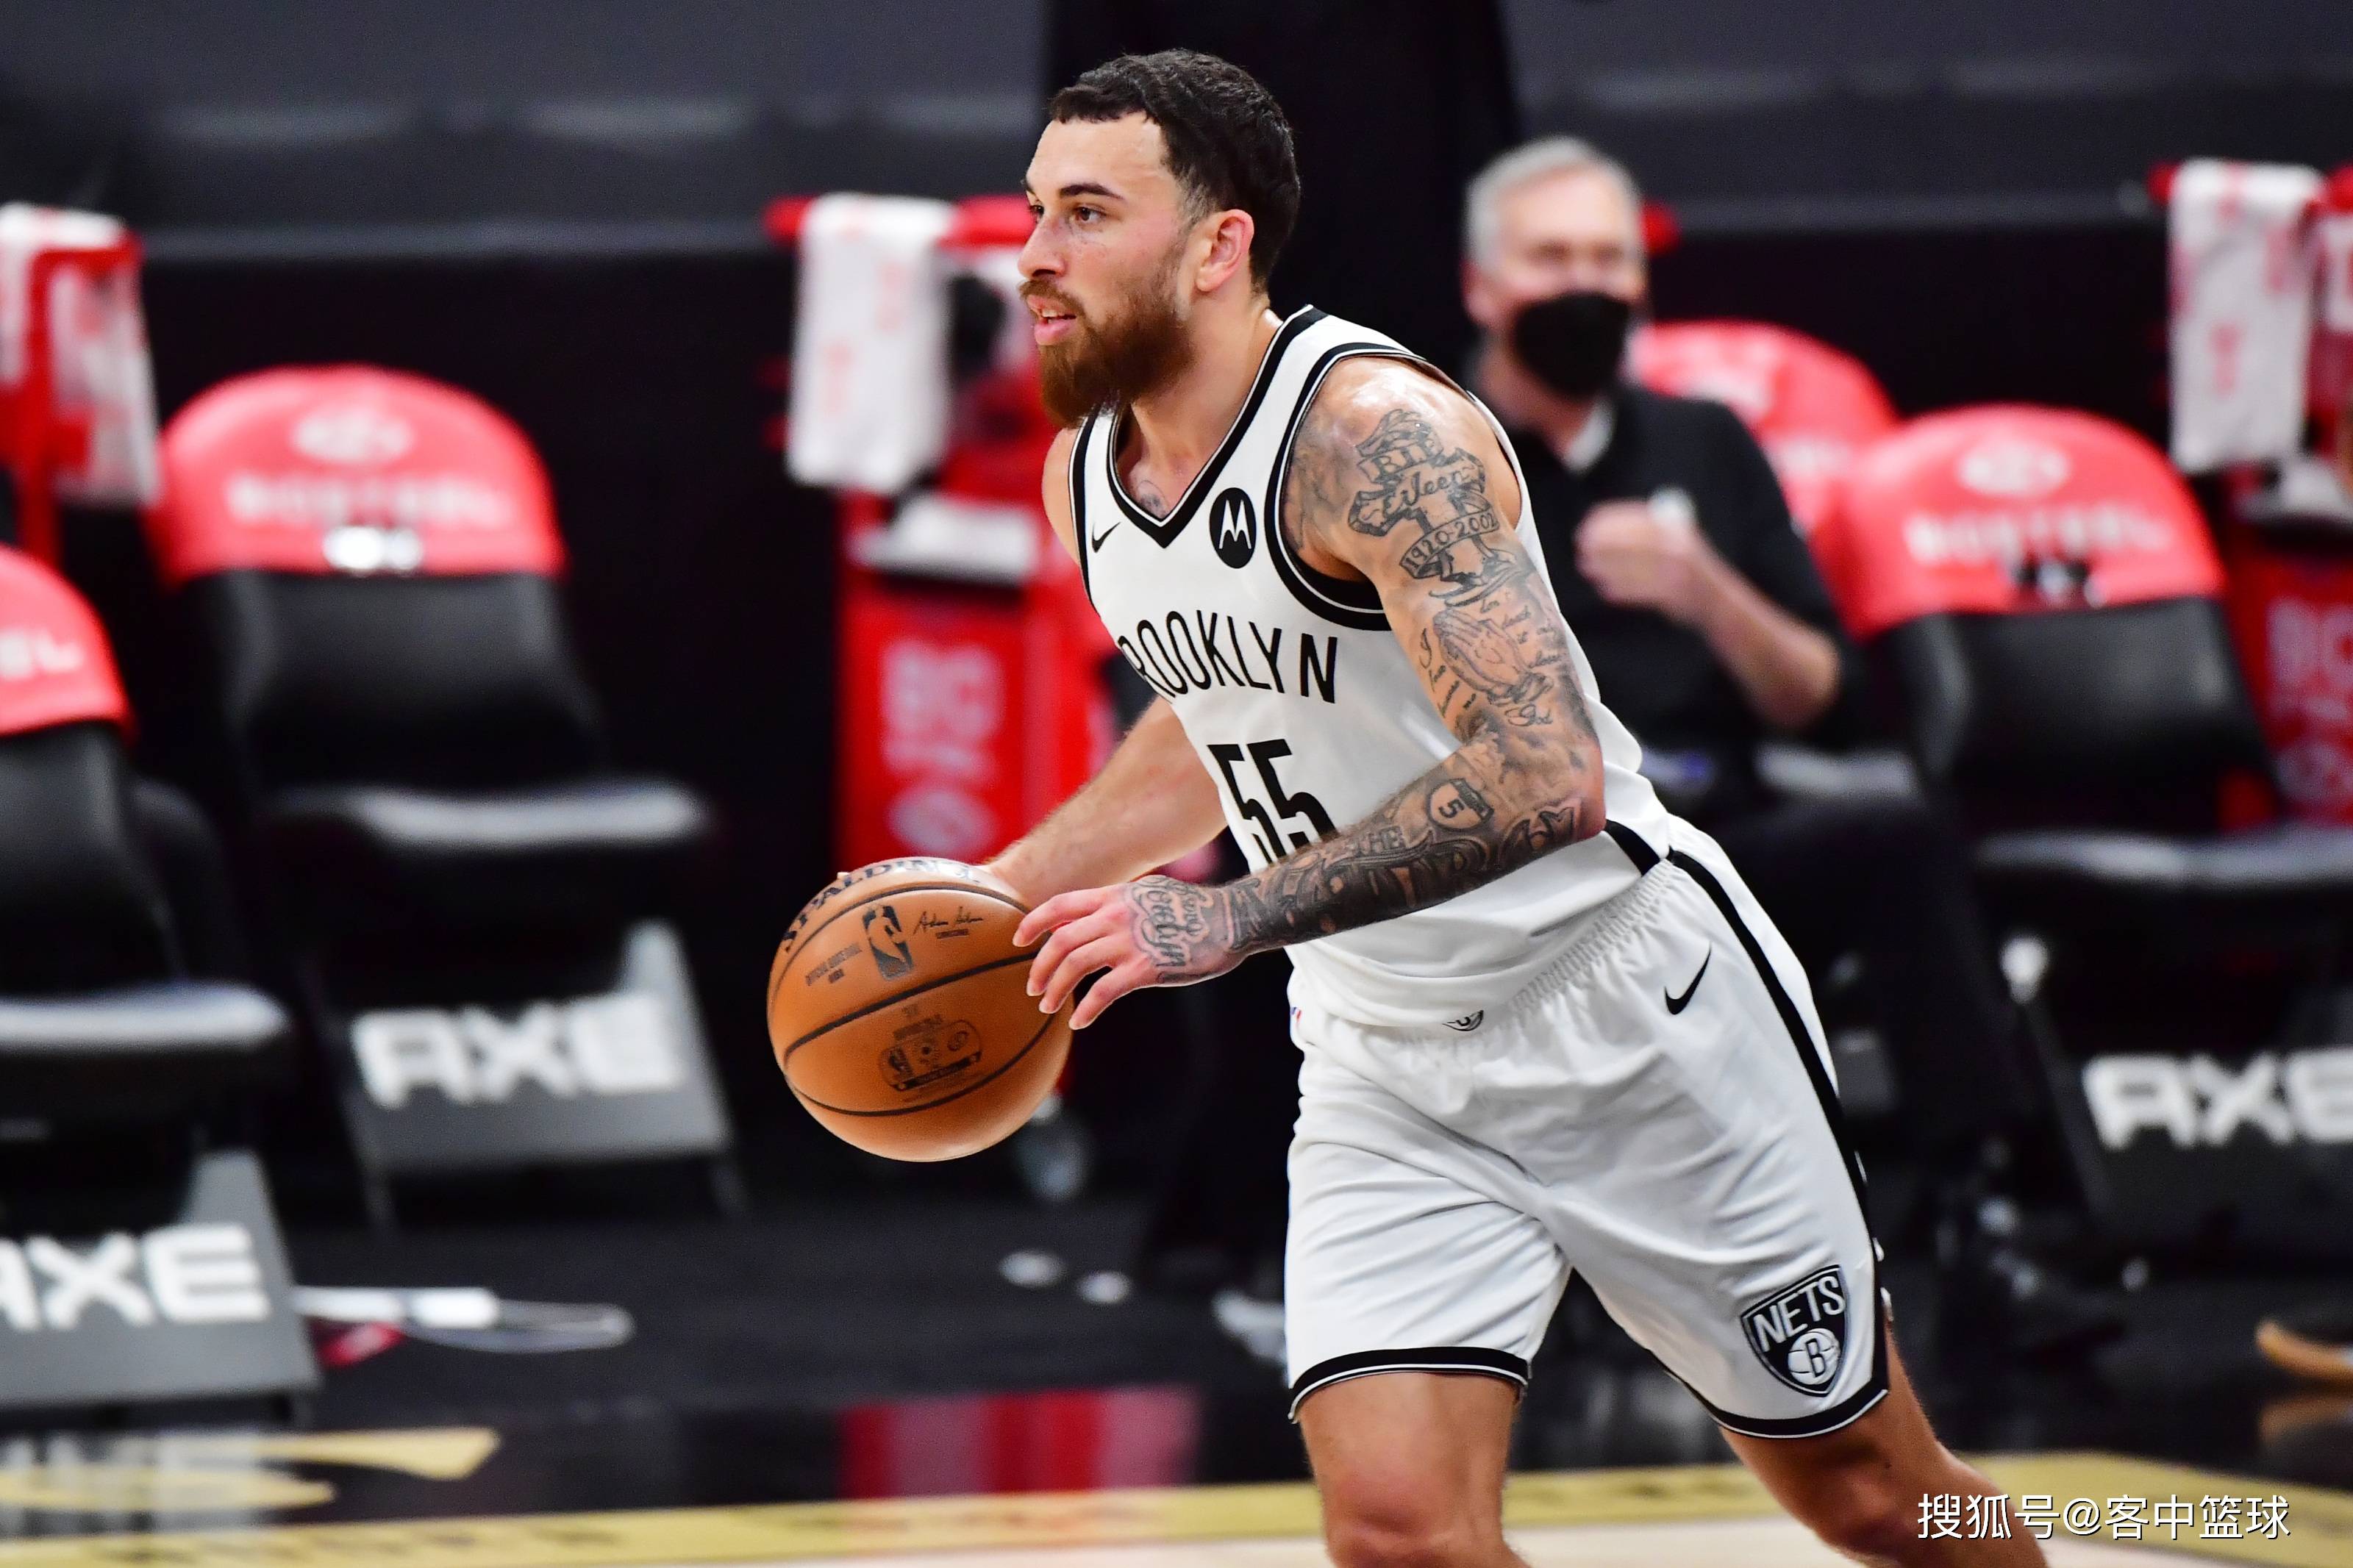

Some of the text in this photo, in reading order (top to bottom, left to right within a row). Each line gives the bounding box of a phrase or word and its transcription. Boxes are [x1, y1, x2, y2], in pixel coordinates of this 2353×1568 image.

[1117, 609, 1338, 704] ROOKLYN
[1207, 738, 1341, 867] 55
[349, 992, 685, 1109] AXE
[1753, 1275, 1846, 1353] NETS
[1804, 1337, 1827, 1378] B
